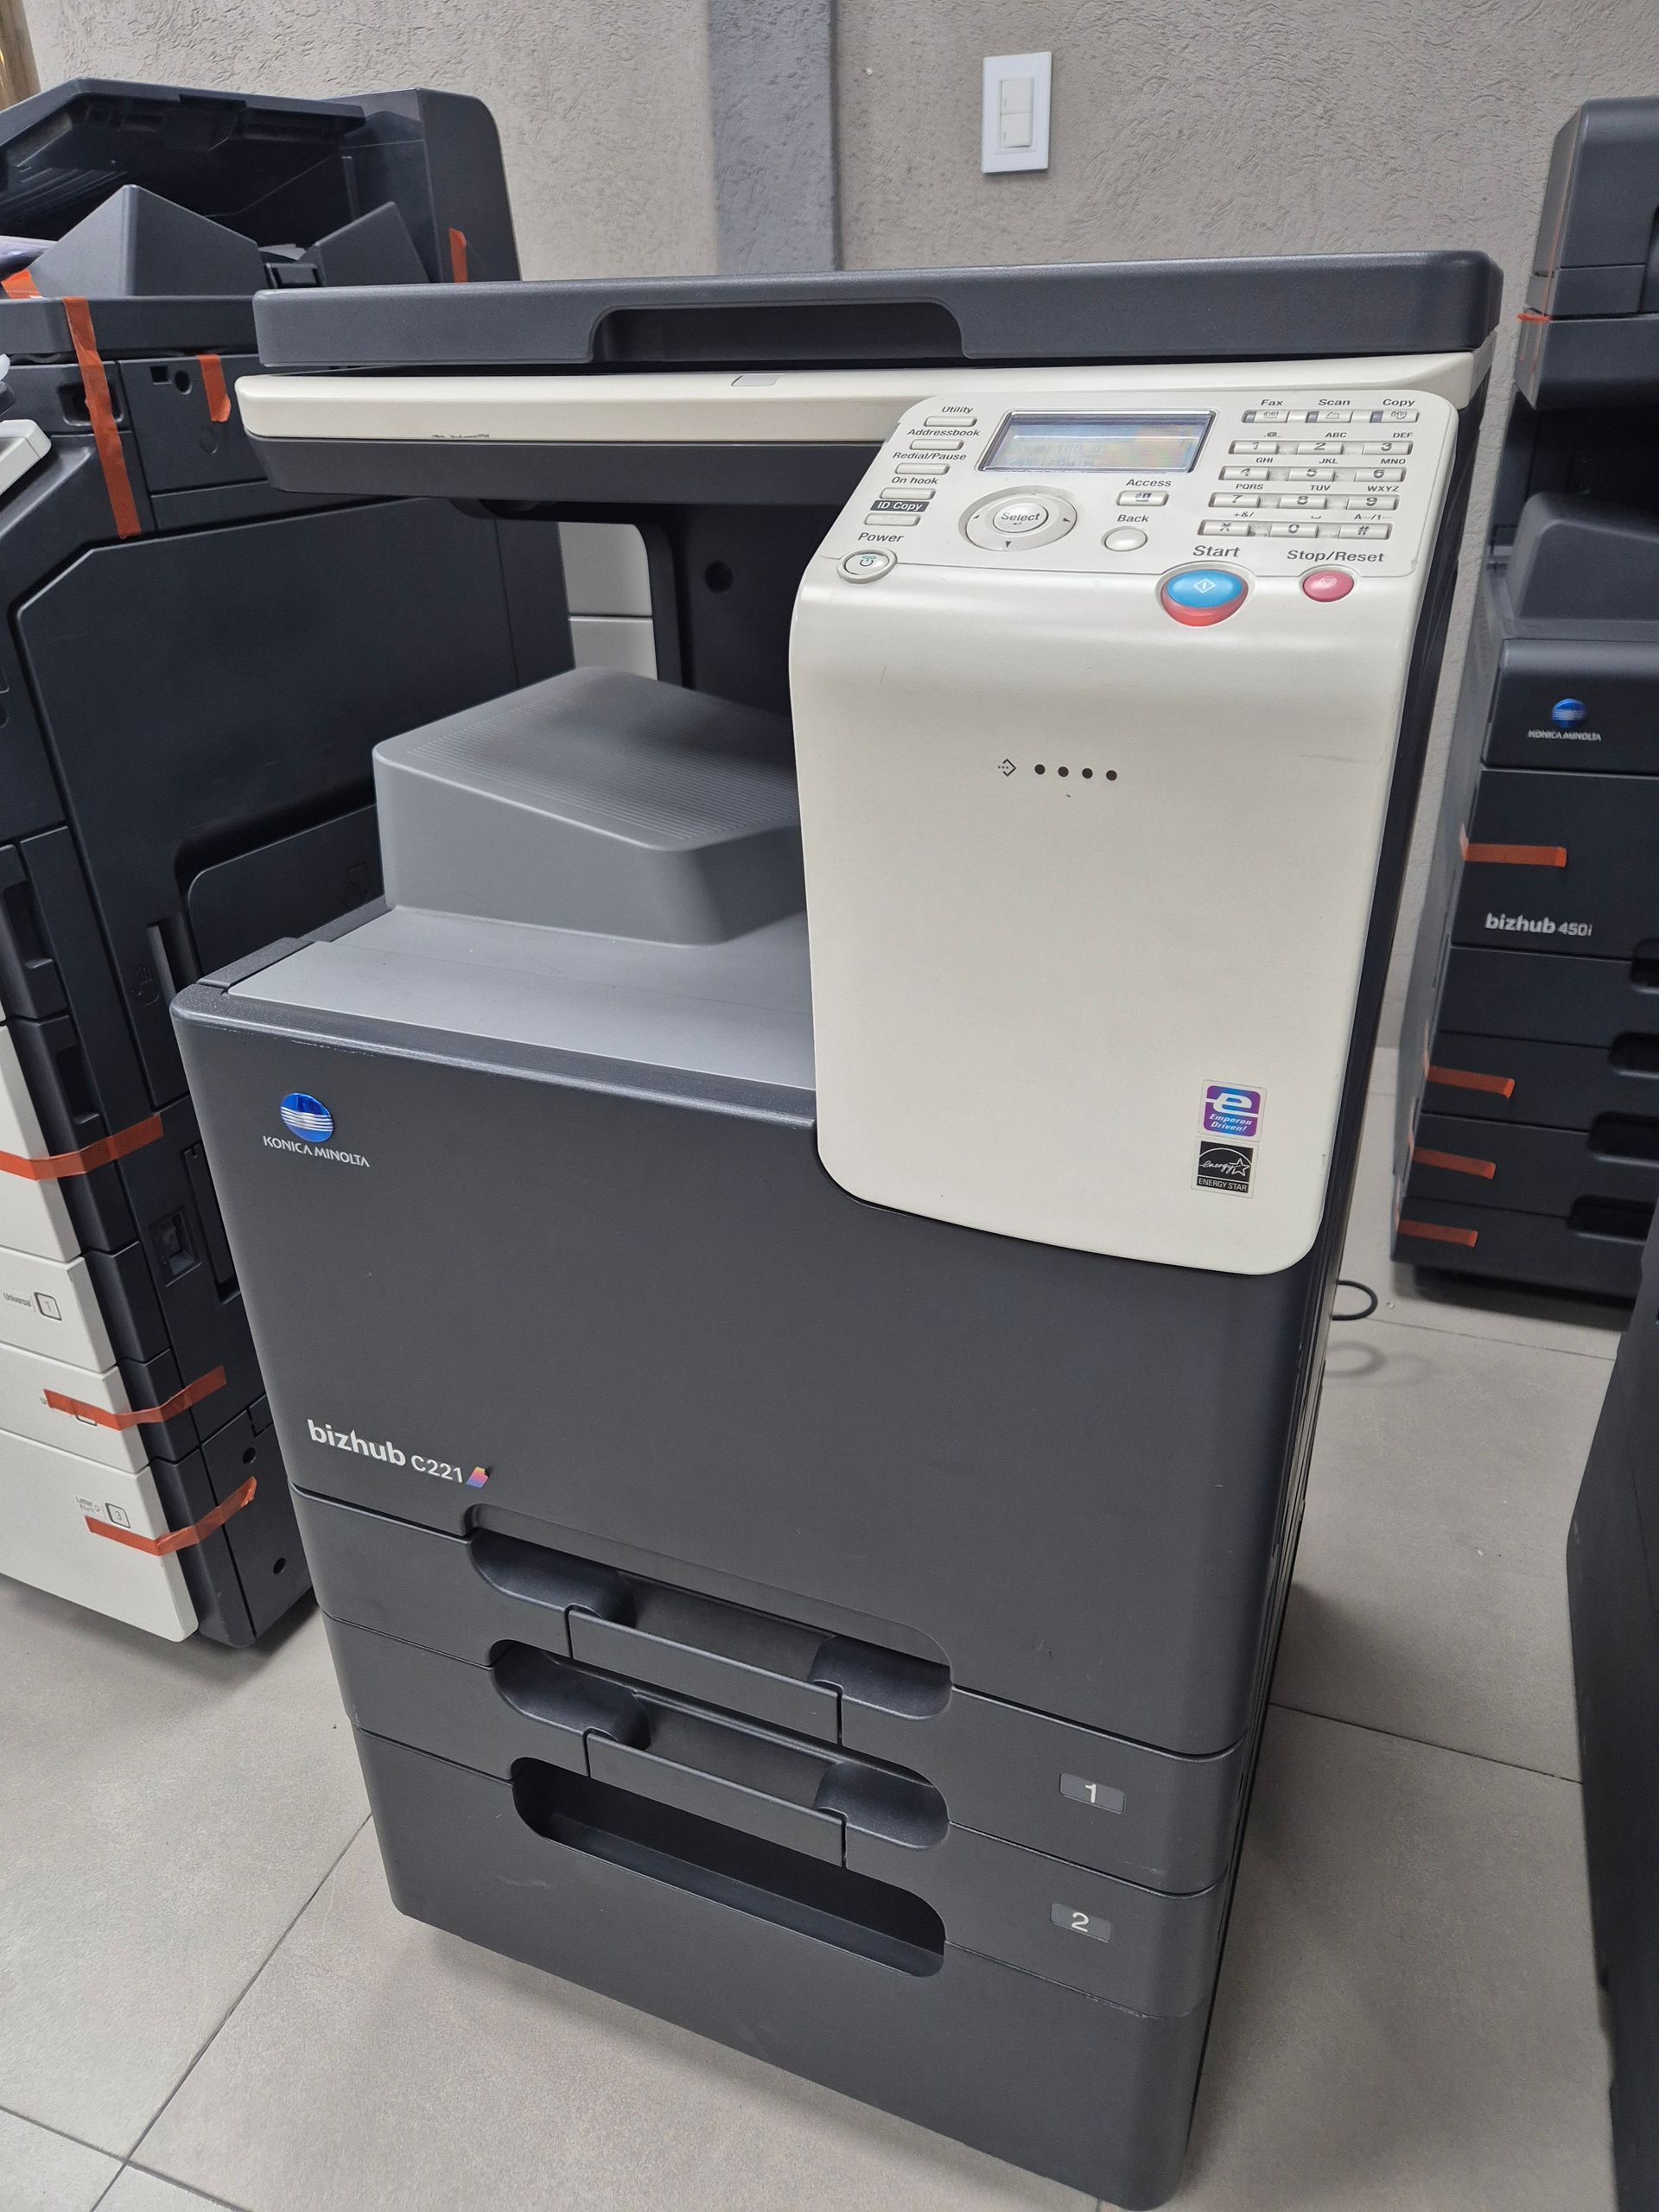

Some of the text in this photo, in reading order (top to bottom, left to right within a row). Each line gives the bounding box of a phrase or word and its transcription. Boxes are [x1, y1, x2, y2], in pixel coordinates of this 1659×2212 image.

[1319, 398, 1351, 407] Scan
[1382, 398, 1415, 407] Copy
[941, 405, 974, 414] Utility
[1313, 442, 1326, 451] 2
[1381, 442, 1392, 452] 3
[893, 452, 967, 461] Redial/Pause
[1306, 468, 1318, 478] 5
[1373, 469, 1385, 479] 6
[909, 476, 938, 485] hook
[1126, 479, 1172, 487] Access
[1232, 494, 1243, 503] 7
[1297, 495, 1308, 505] 8
[1366, 496, 1377, 506] 9
[876, 500, 923, 512] ID Copy
[1001, 512, 1040, 522] Select
[1116, 514, 1149, 523] Back
[1287, 524, 1300, 534] 0
[1357, 525, 1370, 536] #
[857, 532, 904, 543] Power
[1192, 545, 1241, 557] Start
[1287, 550, 1384, 563] Stop/Reset
[1528, 729, 1602, 741] KONICA MINOLTA
[1485, 912, 1593, 937] bizhub 450i
[1210, 1113, 1253, 1126] Emperon
[1210, 1121, 1248, 1133] Driven!
[263, 1135, 371, 1168] KONICA MINOLTA
[1198, 1178, 1248, 1192] ENERGY STAR
[307, 1418, 463, 1484] bizhub C221
[1084, 1783, 1096, 1804] 1
[1071, 1911, 1090, 1933] 2
